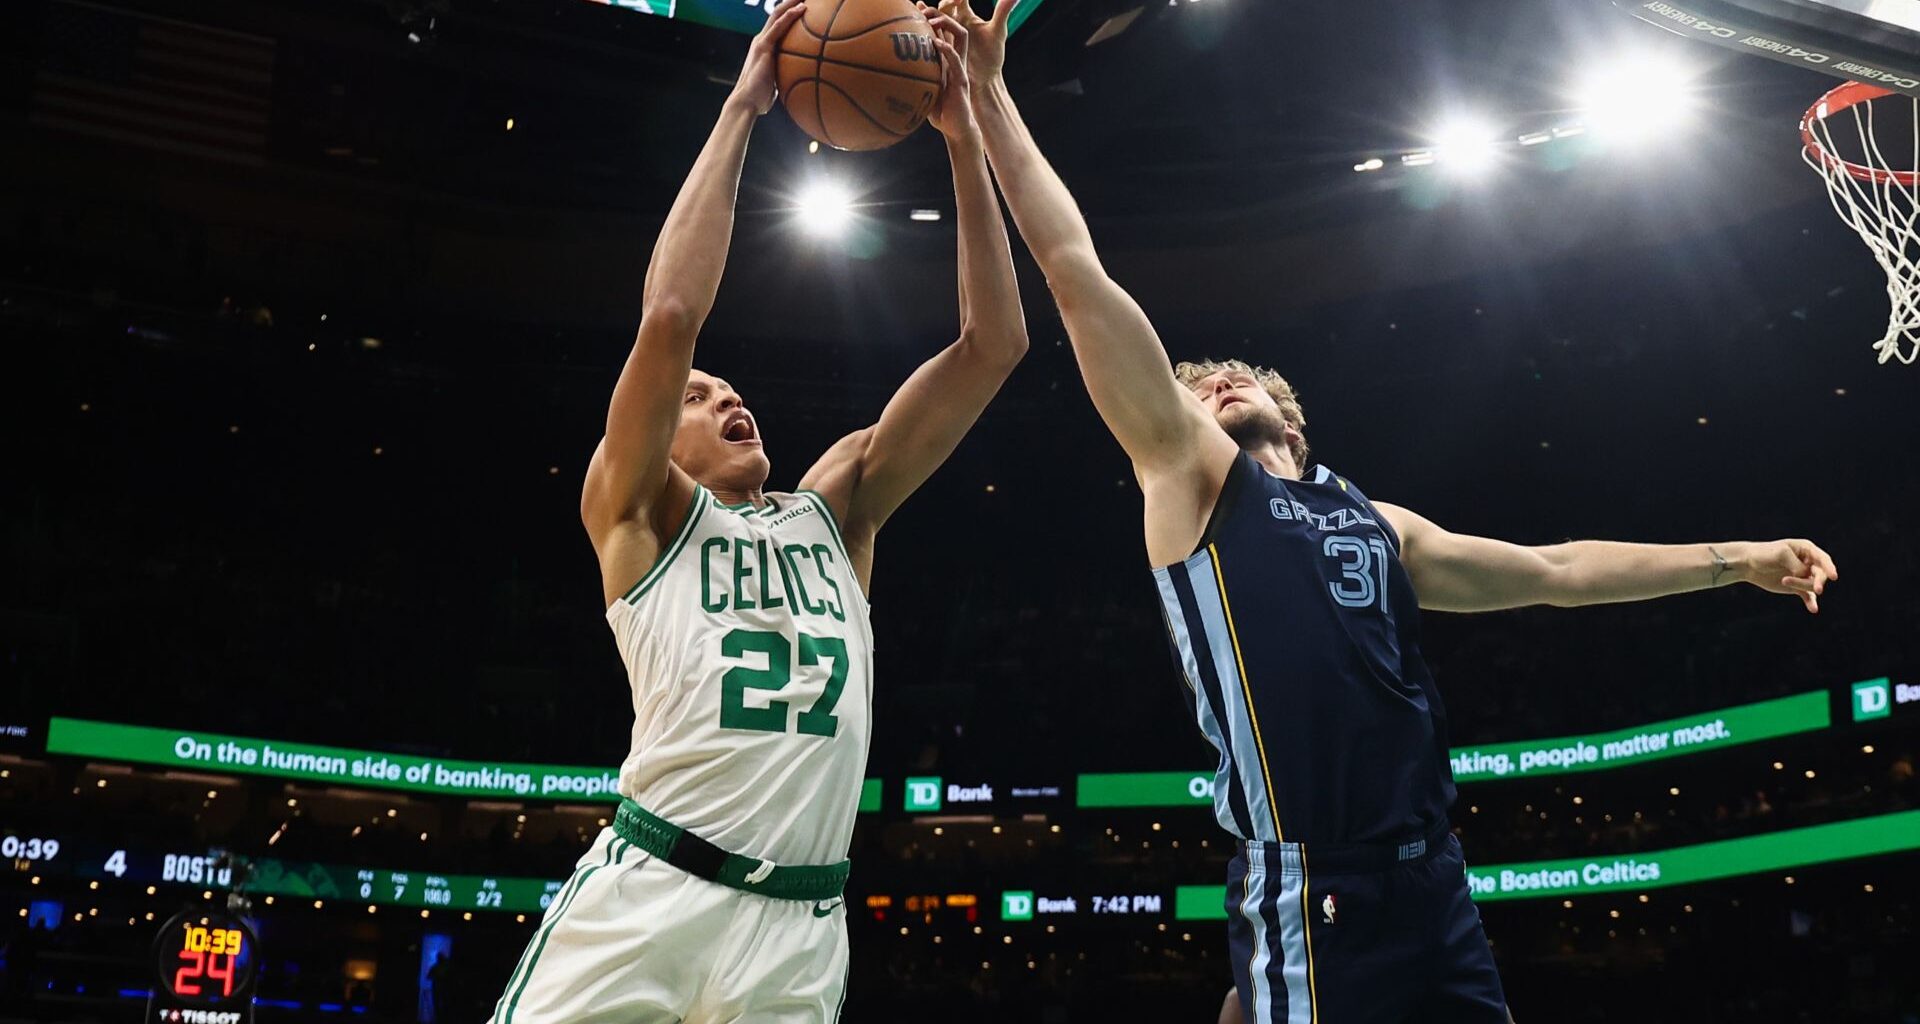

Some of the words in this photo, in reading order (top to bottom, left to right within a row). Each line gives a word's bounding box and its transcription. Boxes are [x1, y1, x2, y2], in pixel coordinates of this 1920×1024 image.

[1643, 1, 1698, 25] ENERGY
[1739, 35, 1792, 55] ENERGY
[1789, 47, 1830, 64] C4
[1830, 60, 1883, 79] ENERGY
[1880, 72, 1919, 89] C4
[1323, 536, 1388, 614] 31
[720, 629, 849, 737] 27
[1855, 685, 1888, 713] TD
[1519, 742, 1597, 771] people
[1602, 732, 1669, 760] matter
[1673, 719, 1731, 746] most.
[175, 737, 211, 761] On
[217, 742, 257, 766] the
[262, 746, 347, 775] human
[351, 757, 401, 781] side
[405, 763, 431, 784] of
[435, 764, 537, 795] banking,
[908, 783, 939, 805] TD
[947, 784, 993, 802] Bank
[104, 850, 127, 877] 4
[1500, 868, 1579, 892] Boston
[1582, 859, 1661, 885] Celtics
[360, 883, 371, 898] 0
[394, 886, 405, 900] 7
[476, 891, 502, 907] 2/2
[1007, 896, 1031, 915] TD
[1037, 896, 1077, 913] Bank
[1092, 895, 1129, 914] 7:42
[1133, 895, 1161, 913] PM
[185, 926, 242, 956] 10:39
[175, 950, 236, 997] 24
